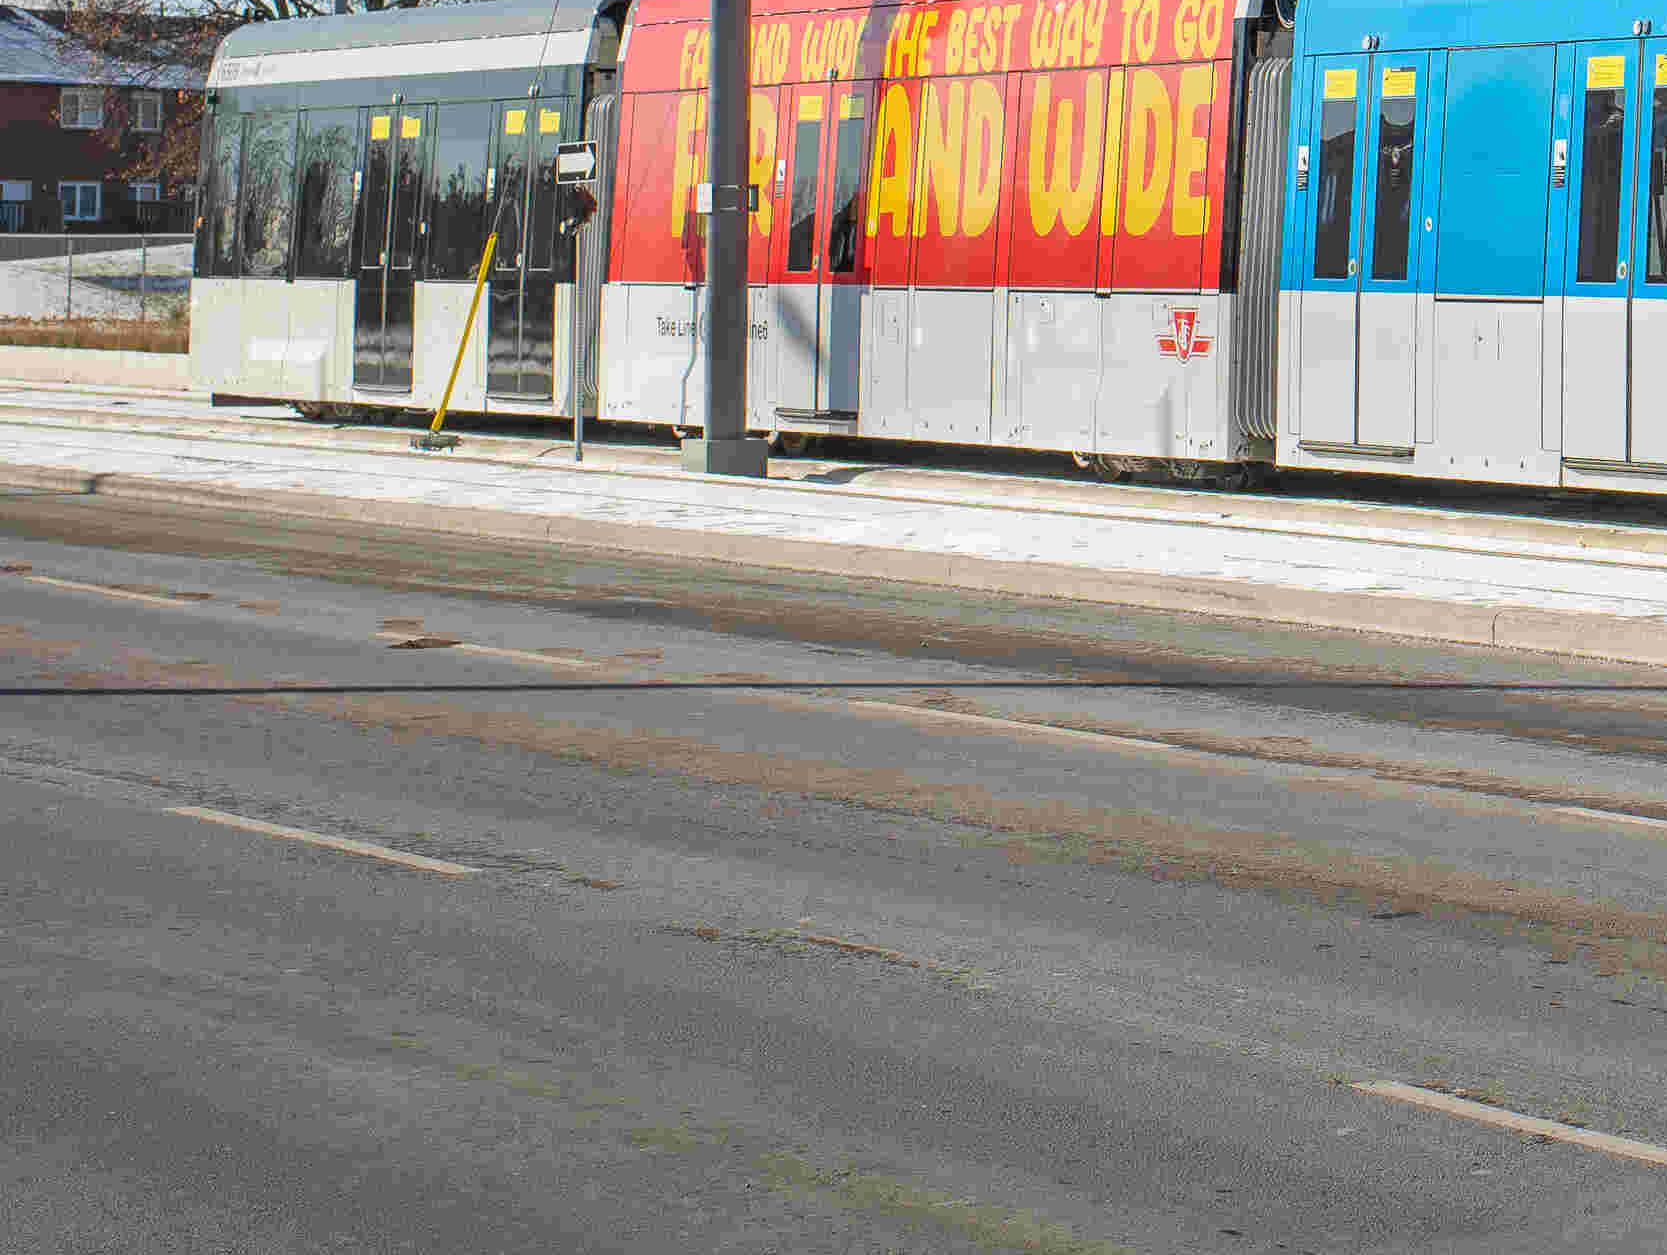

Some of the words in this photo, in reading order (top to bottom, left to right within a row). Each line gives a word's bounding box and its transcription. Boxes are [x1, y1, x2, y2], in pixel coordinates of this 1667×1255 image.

[945, 3, 1022, 75] BEST
[865, 80, 1005, 237] AND
[1027, 62, 1217, 237] WIDE
